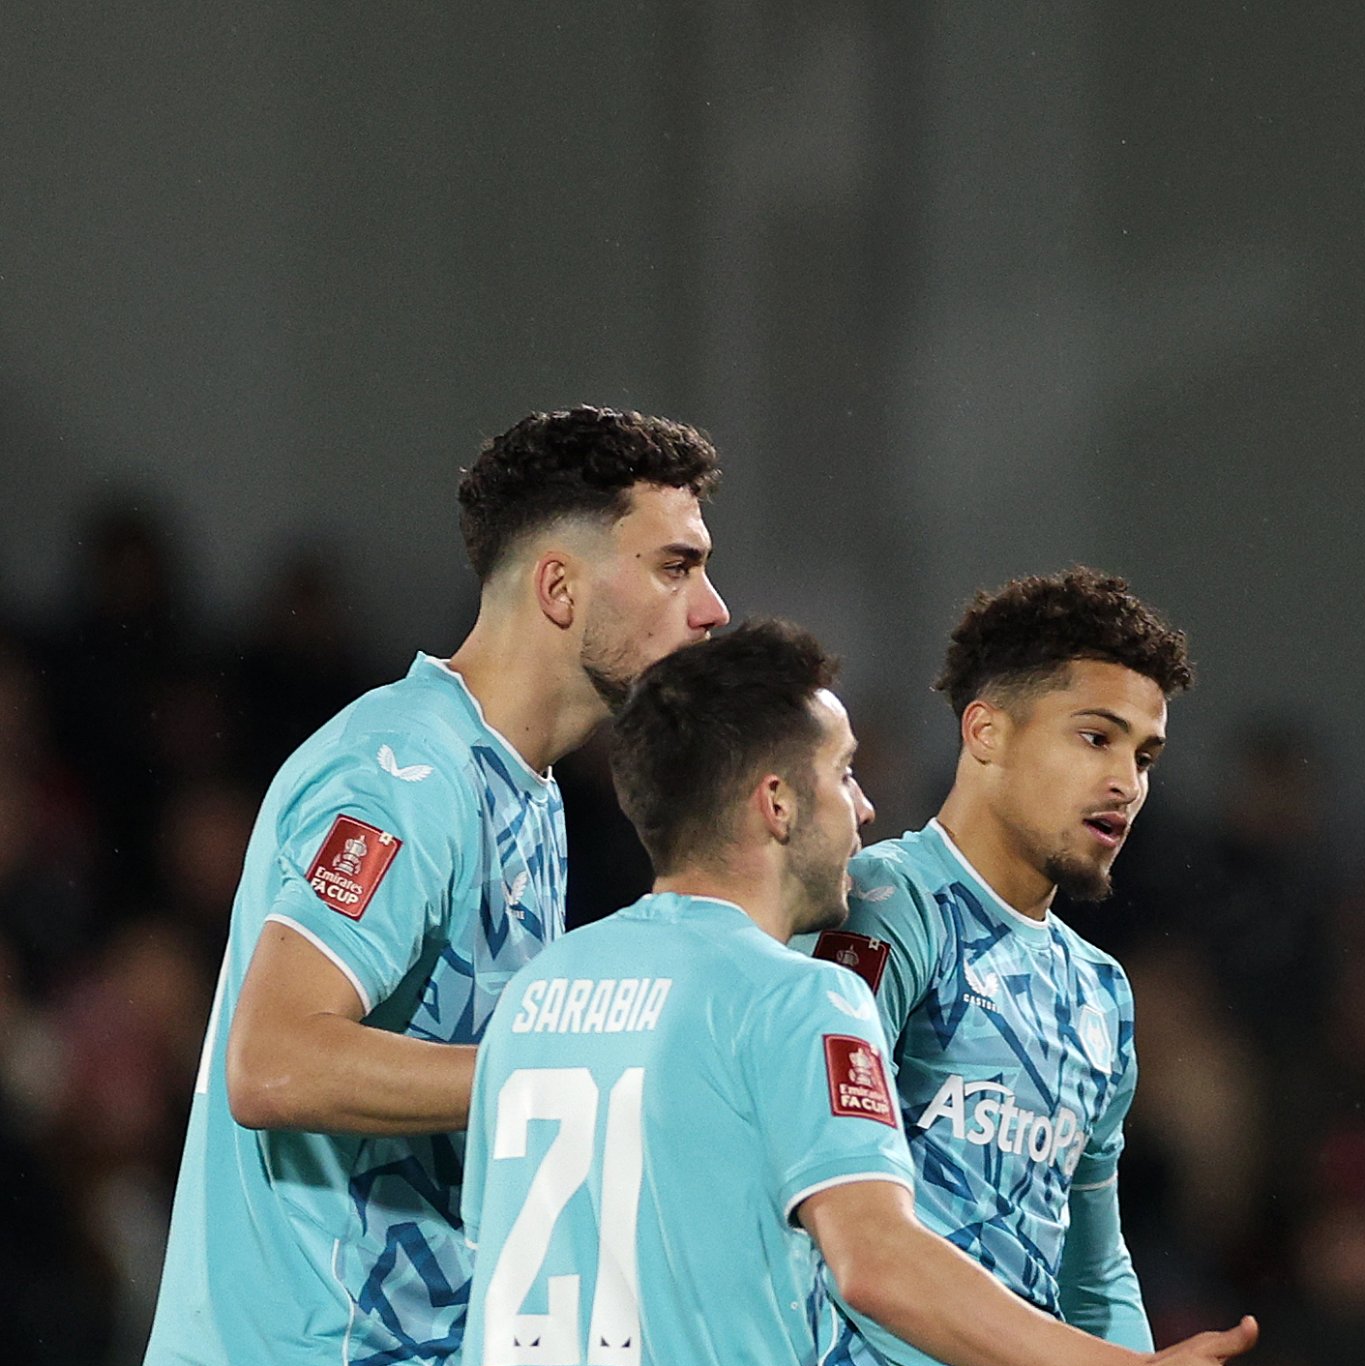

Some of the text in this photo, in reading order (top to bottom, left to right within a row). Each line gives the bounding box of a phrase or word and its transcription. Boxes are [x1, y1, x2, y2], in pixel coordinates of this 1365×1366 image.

[314, 866, 363, 896] Emirates
[327, 883, 359, 905] CUP
[512, 978, 672, 1034] SARABIA
[916, 1073, 1089, 1176] AstroPa
